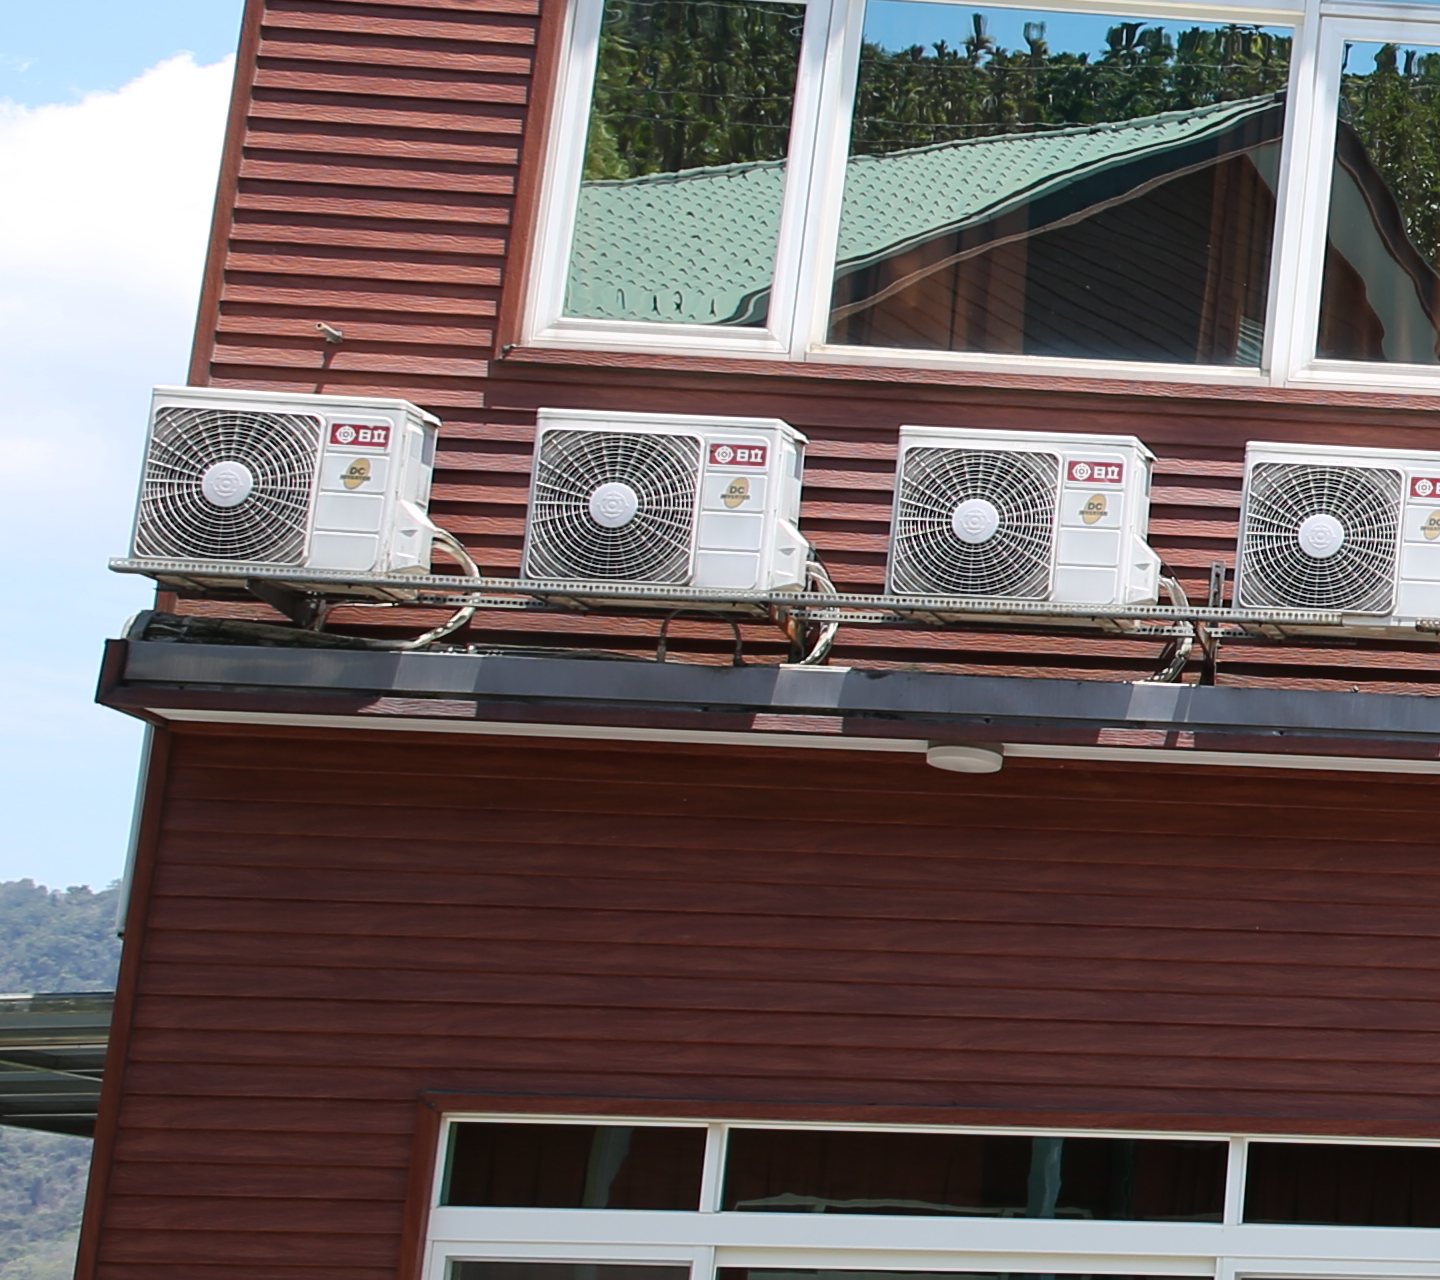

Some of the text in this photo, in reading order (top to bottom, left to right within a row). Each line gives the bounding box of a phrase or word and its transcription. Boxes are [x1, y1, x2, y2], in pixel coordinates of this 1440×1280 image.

[358, 429, 386, 442] 日立
[737, 449, 763, 462] 日立
[350, 467, 365, 475] DC
[1094, 466, 1119, 479] 日立
[729, 486, 744, 494] DC
[1088, 502, 1102, 510] DC
